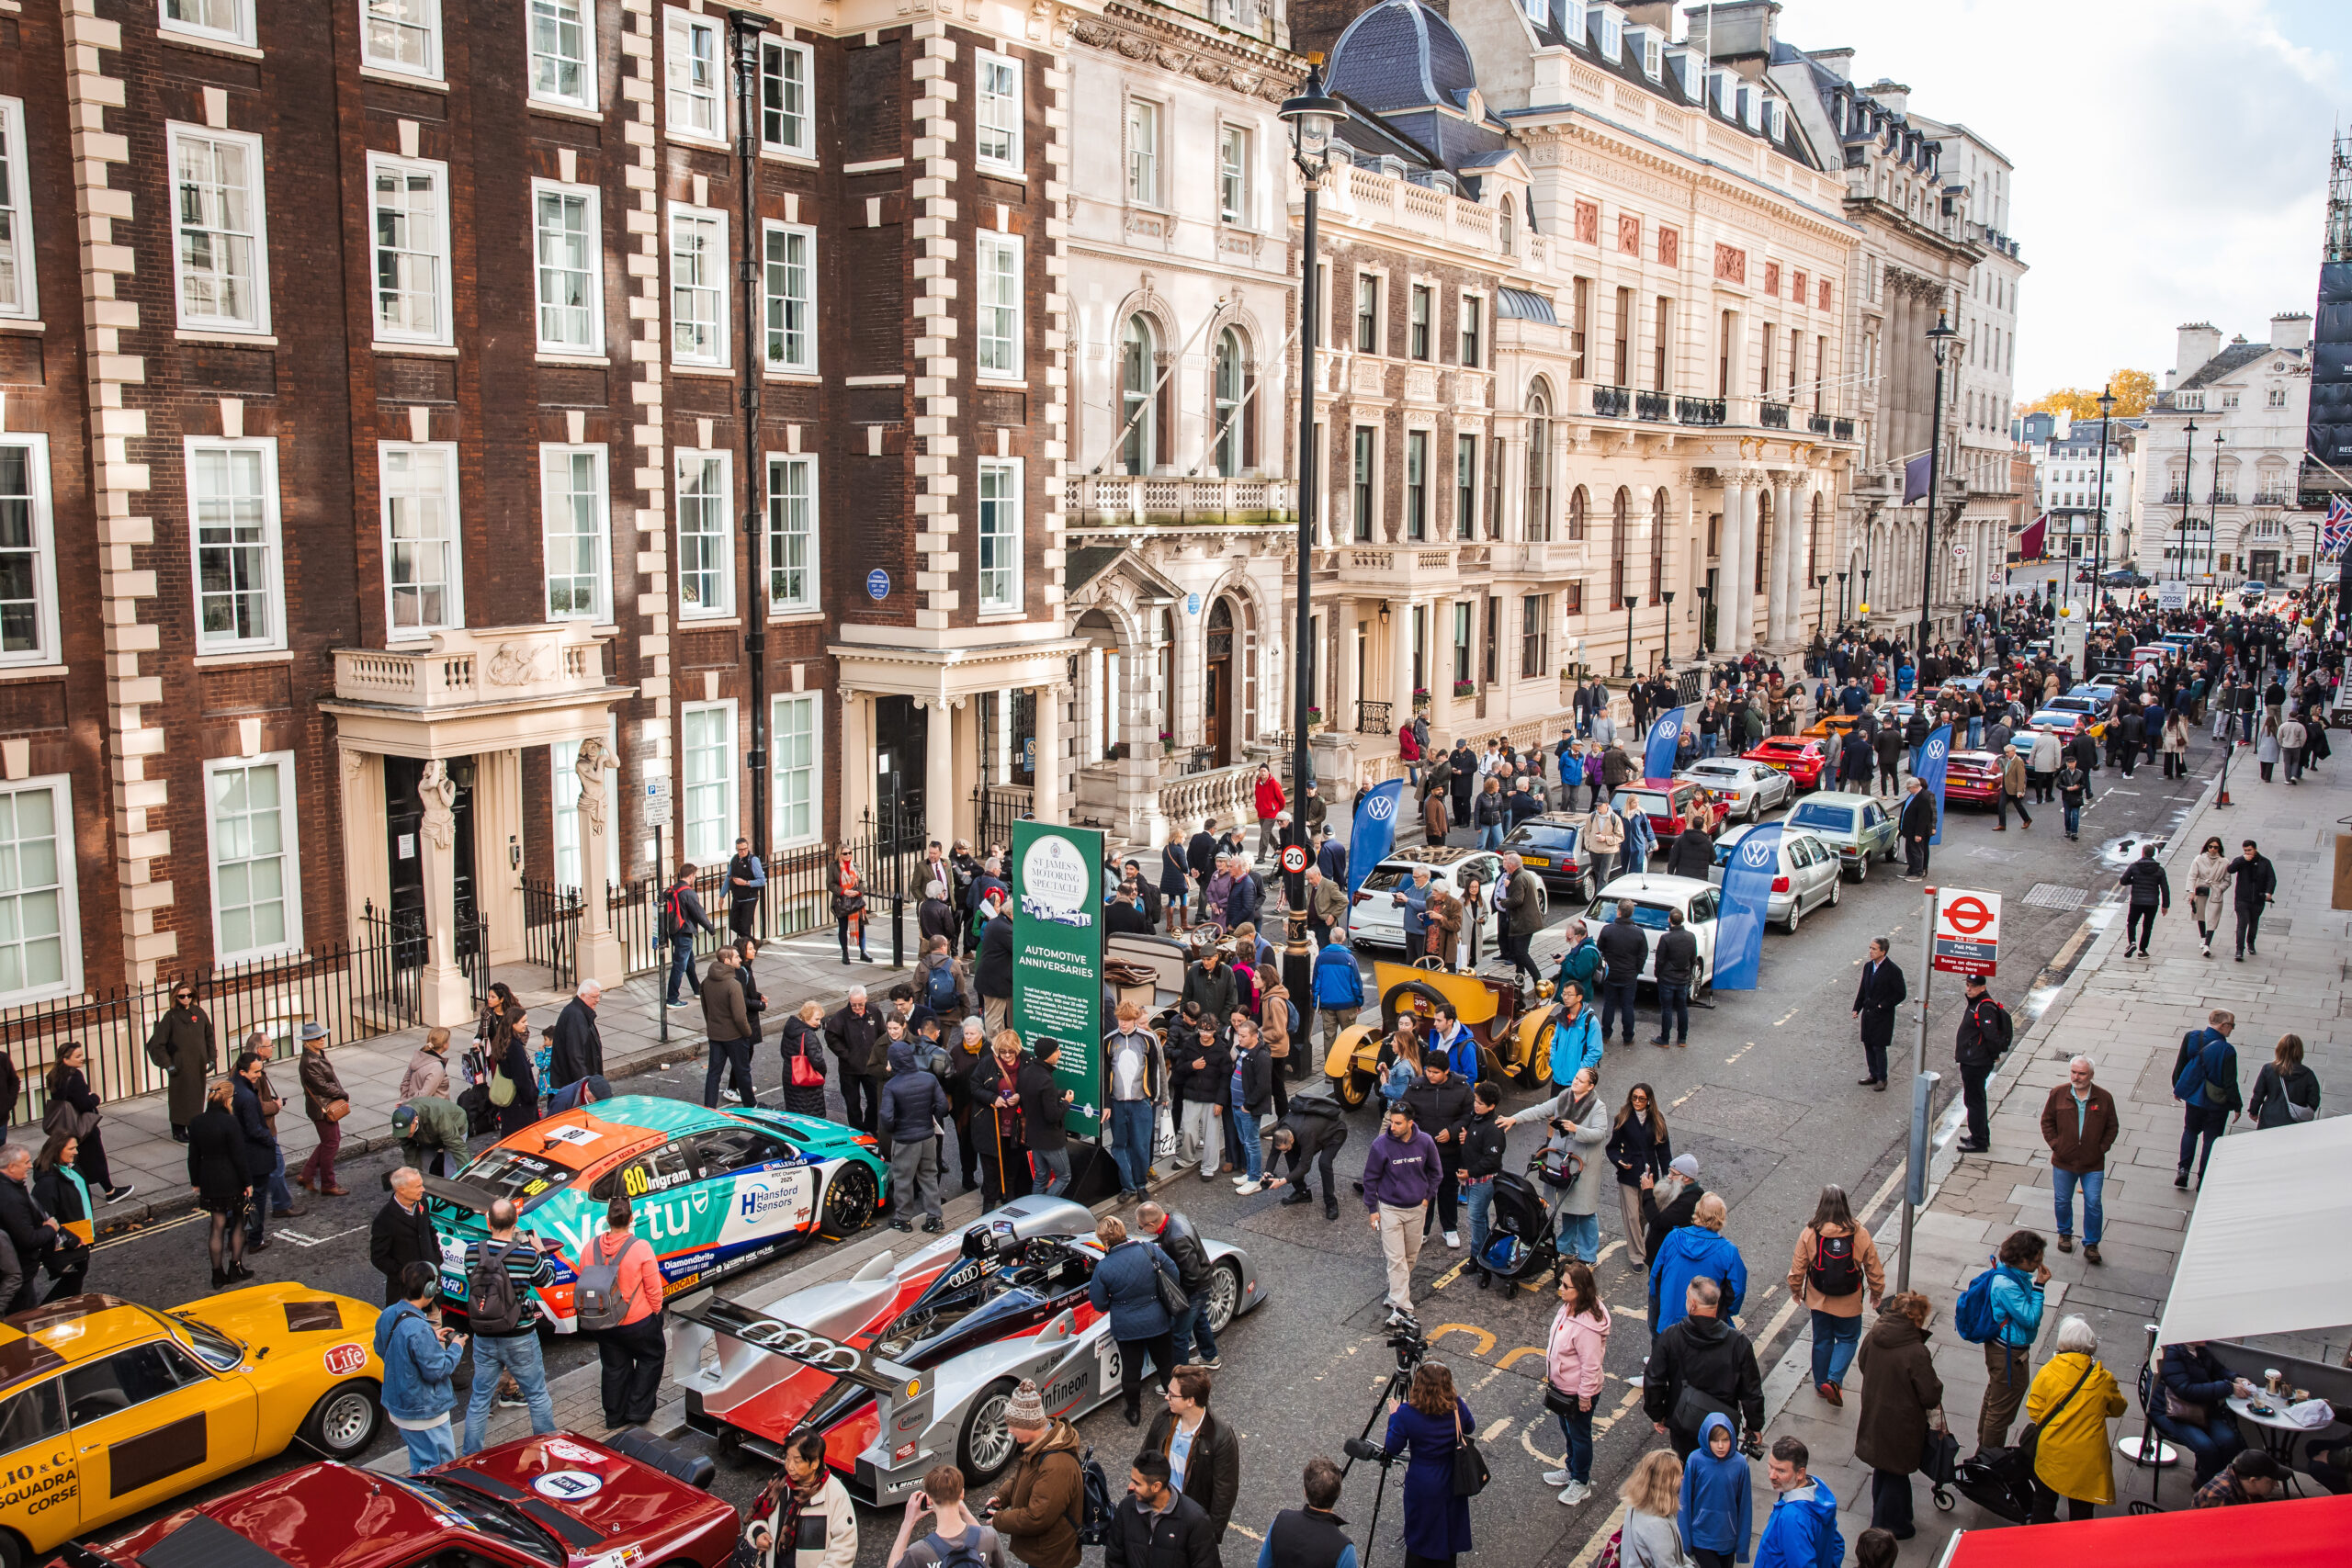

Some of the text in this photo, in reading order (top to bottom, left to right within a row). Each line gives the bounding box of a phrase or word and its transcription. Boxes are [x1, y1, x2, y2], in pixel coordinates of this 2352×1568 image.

[1033, 858, 1044, 866] ST
[1286, 853, 1303, 865] 20
[1032, 867, 1080, 883] MOTORING
[1032, 878, 1080, 894] SPECTACLE
[1024, 945, 1087, 964] AUTOMOTIVE
[1018, 955, 1093, 978] ANNIVERSARIES
[1965, 960, 1990, 968] diversion
[1414, 998, 1428, 1007] 395
[561, 1129, 586, 1140] 80
[772, 1160, 796, 1169] MILLERS
[523, 1179, 549, 1196] 80
[623, 1166, 648, 1196] 80
[646, 1168, 691, 1190] Ingram
[757, 1184, 798, 1202] Hansford
[756, 1198, 792, 1213] Sensors
[664, 1252, 715, 1269] Diamondbrite
[1057, 1297, 1069, 1308] Audi
[1069, 1291, 1082, 1303] Sport
[326, 1348, 364, 1372] Life
[1035, 1350, 1065, 1376] Audi Bank
[1109, 1352, 1120, 1379] 3
[40, 1463, 51, 1473] &
[52, 1451, 74, 1467] C.
[28, 1484, 78, 1516] CORSE
